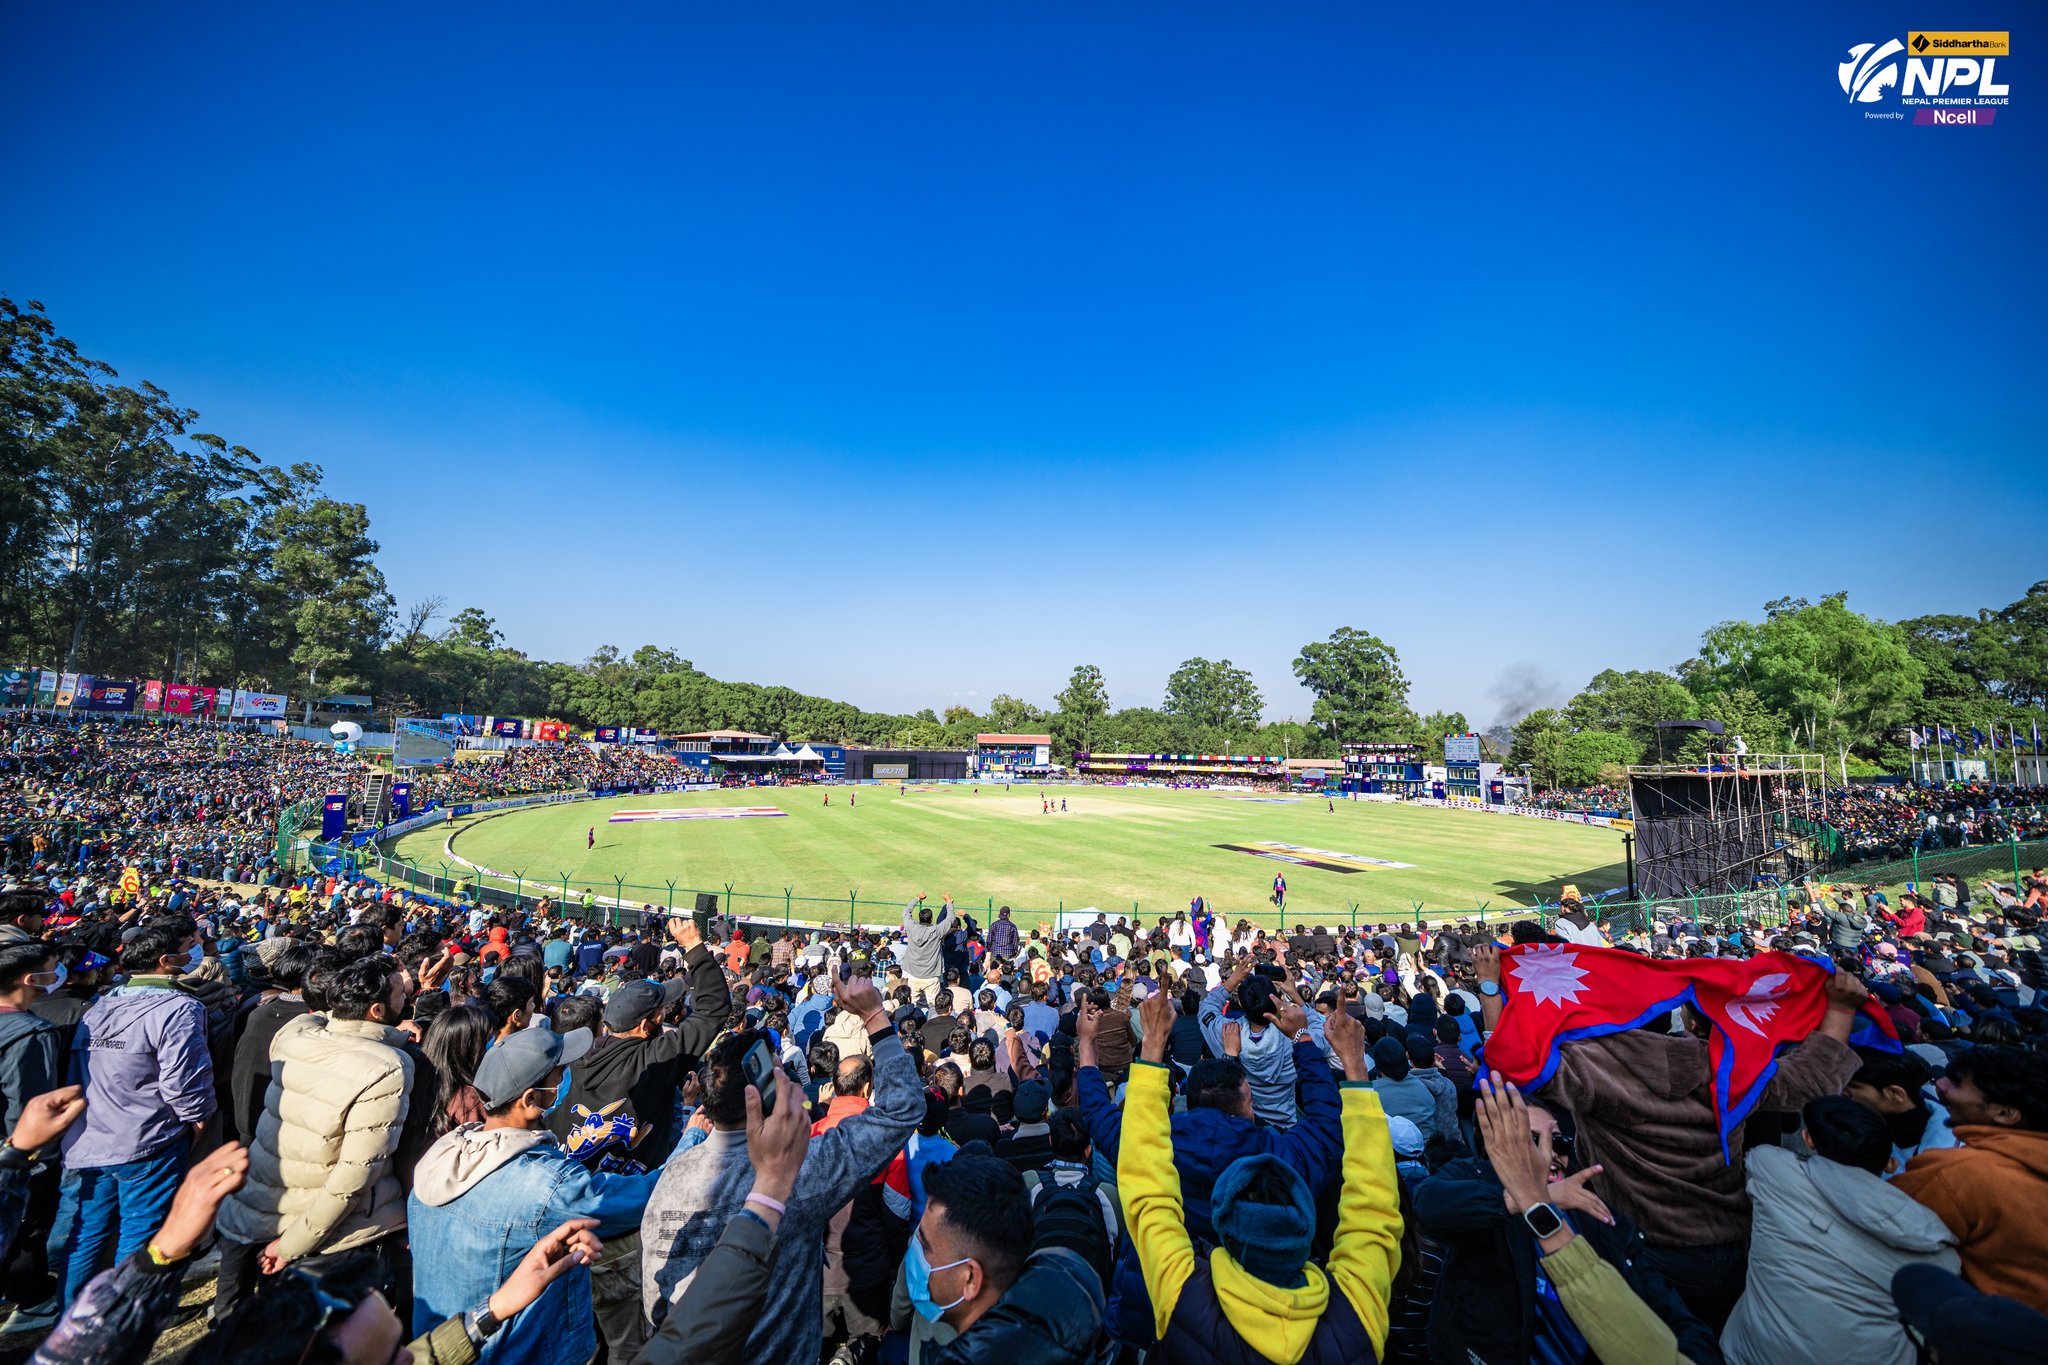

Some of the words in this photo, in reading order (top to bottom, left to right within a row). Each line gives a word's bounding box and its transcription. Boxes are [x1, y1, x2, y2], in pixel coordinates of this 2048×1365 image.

[104, 692, 126, 700] NPL
[457, 806, 470, 814] vivo
[124, 875, 139, 893] 6
[1034, 964, 1049, 983] 6
